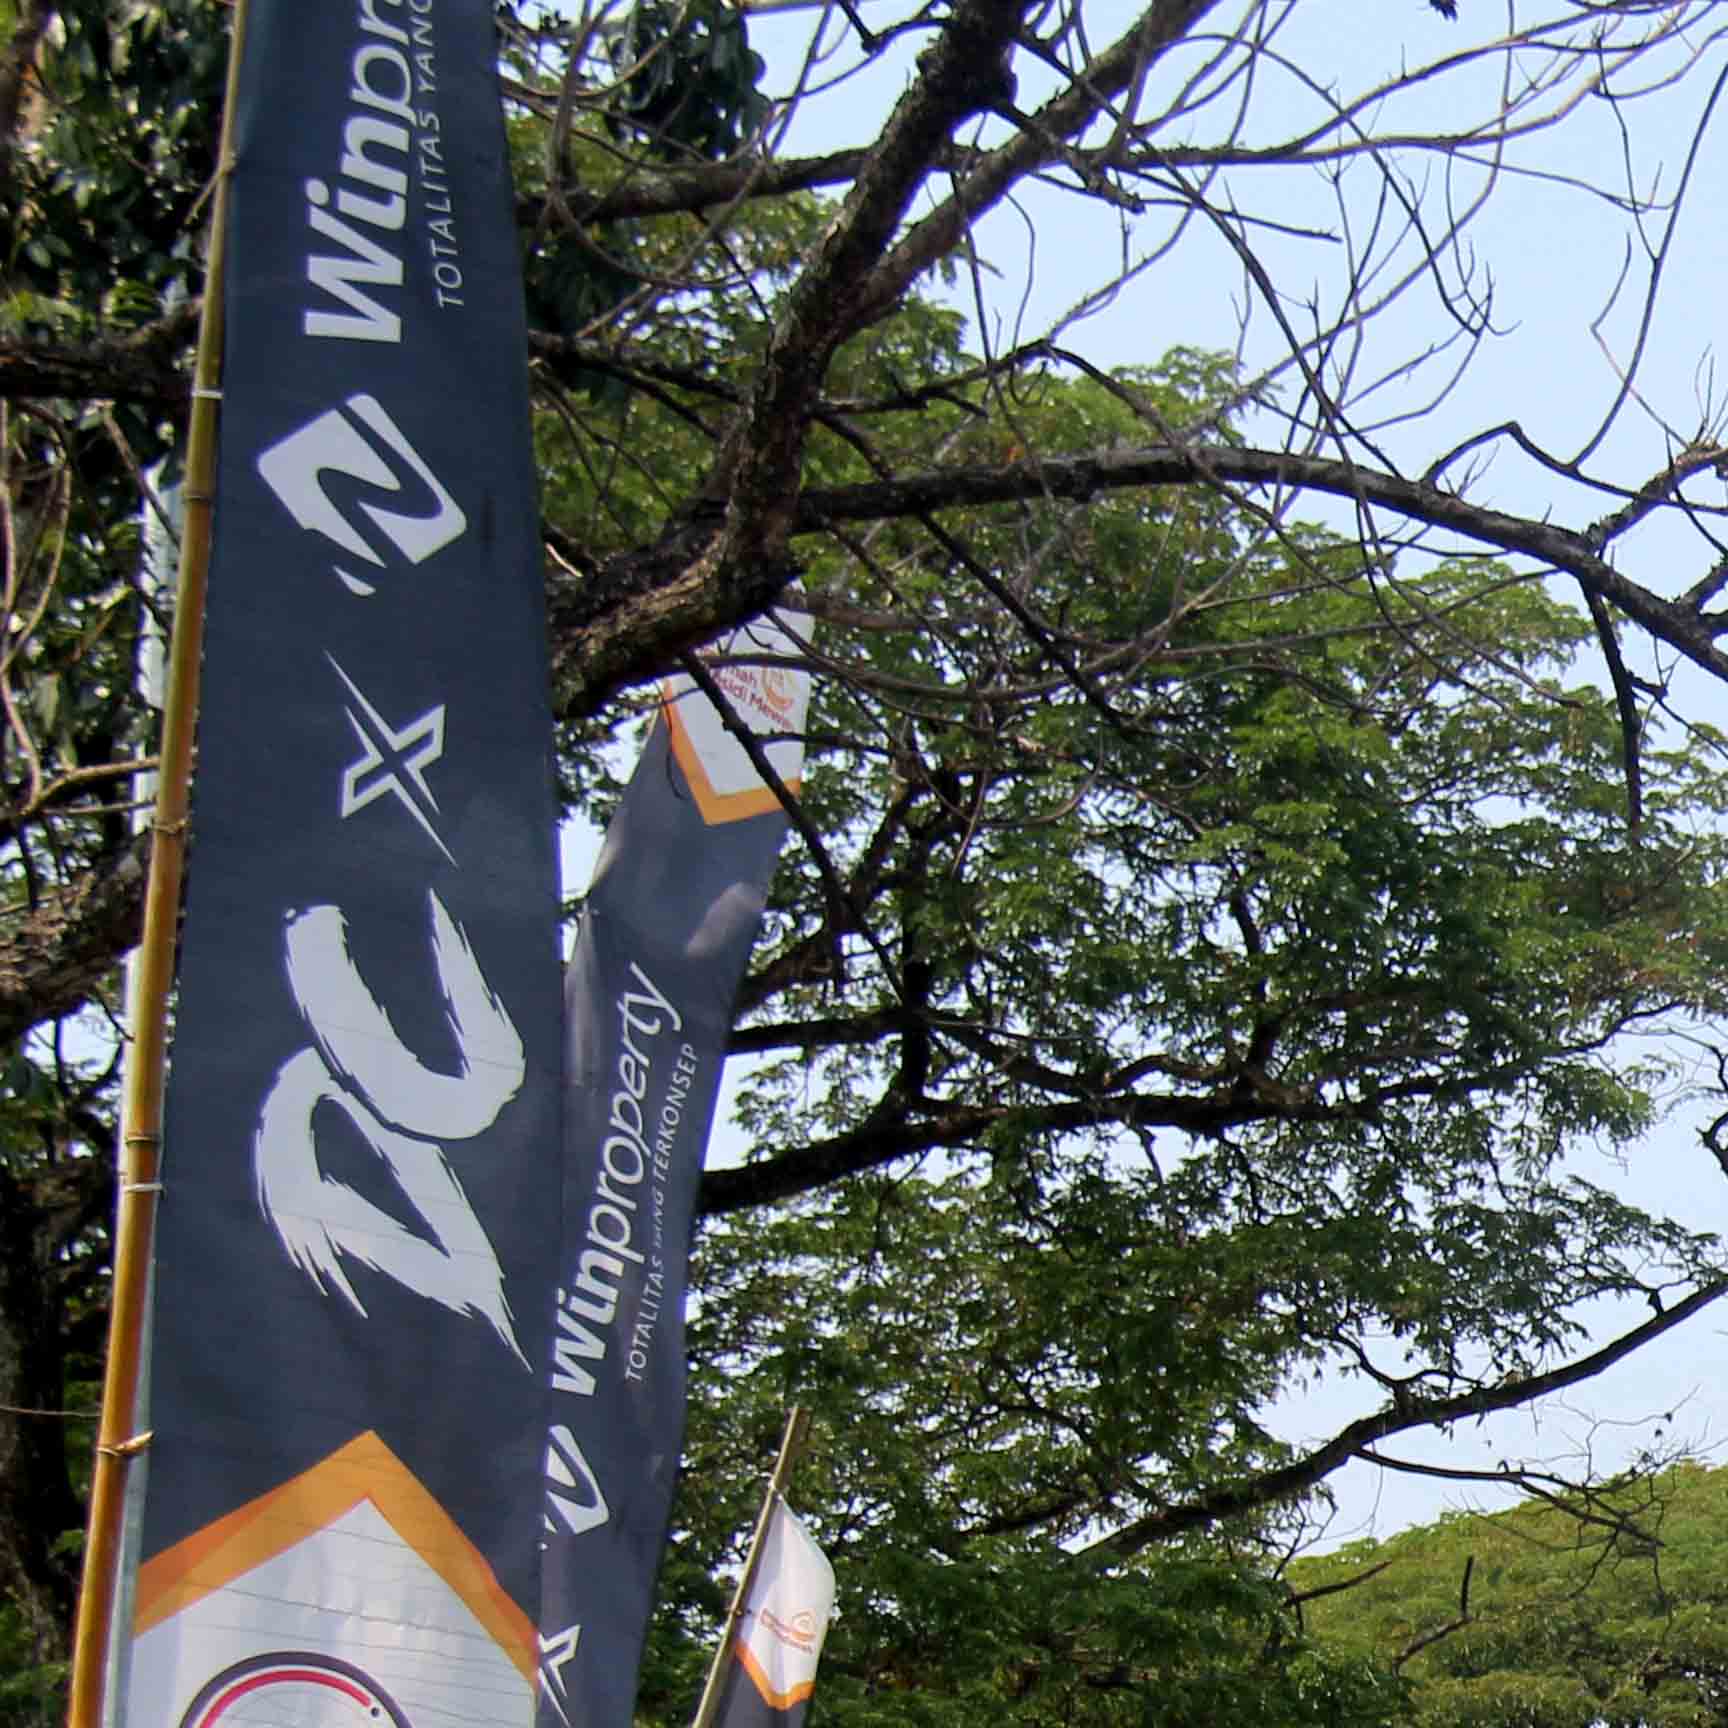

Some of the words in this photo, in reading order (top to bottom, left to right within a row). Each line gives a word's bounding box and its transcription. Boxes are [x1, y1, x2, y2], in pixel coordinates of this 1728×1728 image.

[304, 0, 417, 343] Winpr
[418, 108, 465, 309] TOTALITAS
[551, 960, 683, 1398] Winproperty
[624, 1257, 665, 1383] TOTALITAS
[654, 1042, 699, 1186] TERKONSEP
